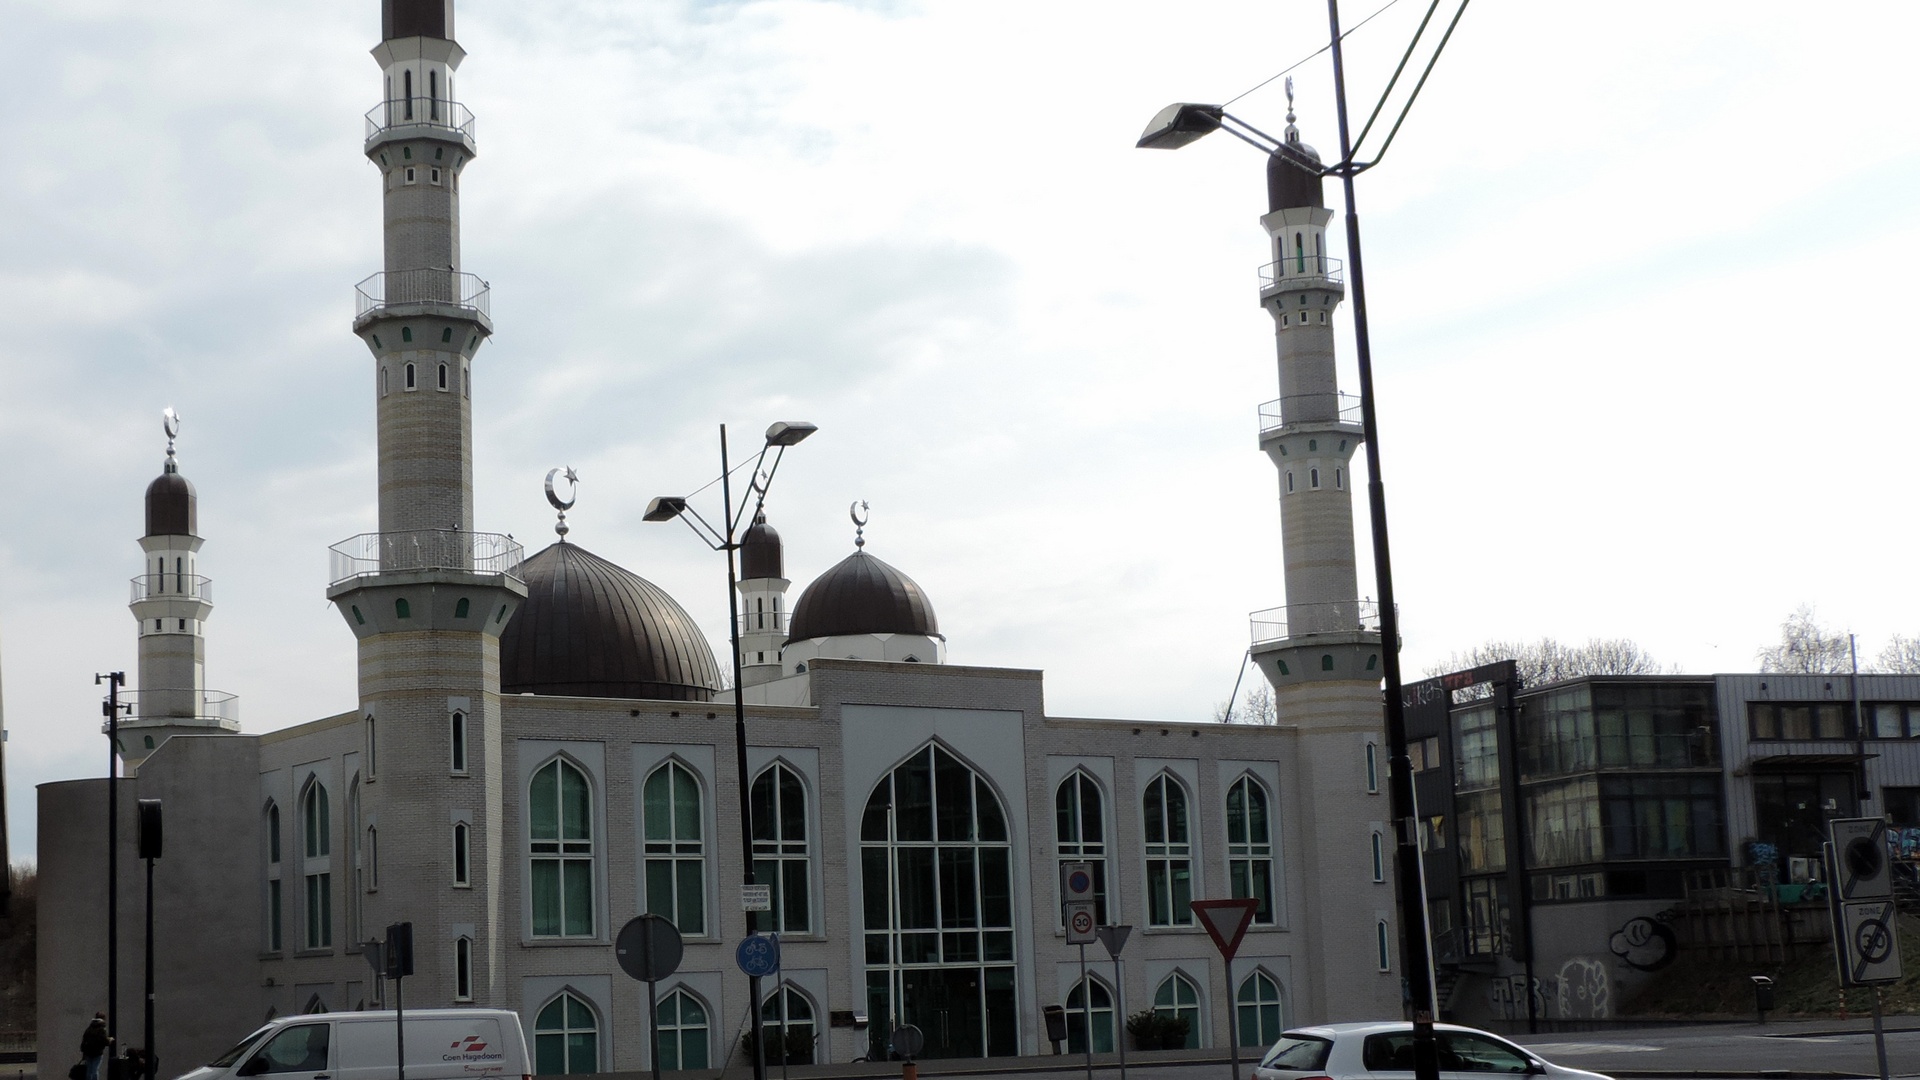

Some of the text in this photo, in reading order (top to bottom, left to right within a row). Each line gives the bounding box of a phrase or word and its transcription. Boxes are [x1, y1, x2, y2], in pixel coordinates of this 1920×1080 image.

[1848, 824, 1872, 834] ZONE
[1859, 906, 1882, 916] ZONE
[1076, 918, 1089, 927] 30
[1862, 931, 1886, 951] 30
[463, 1052, 502, 1062] Hagedoorn
